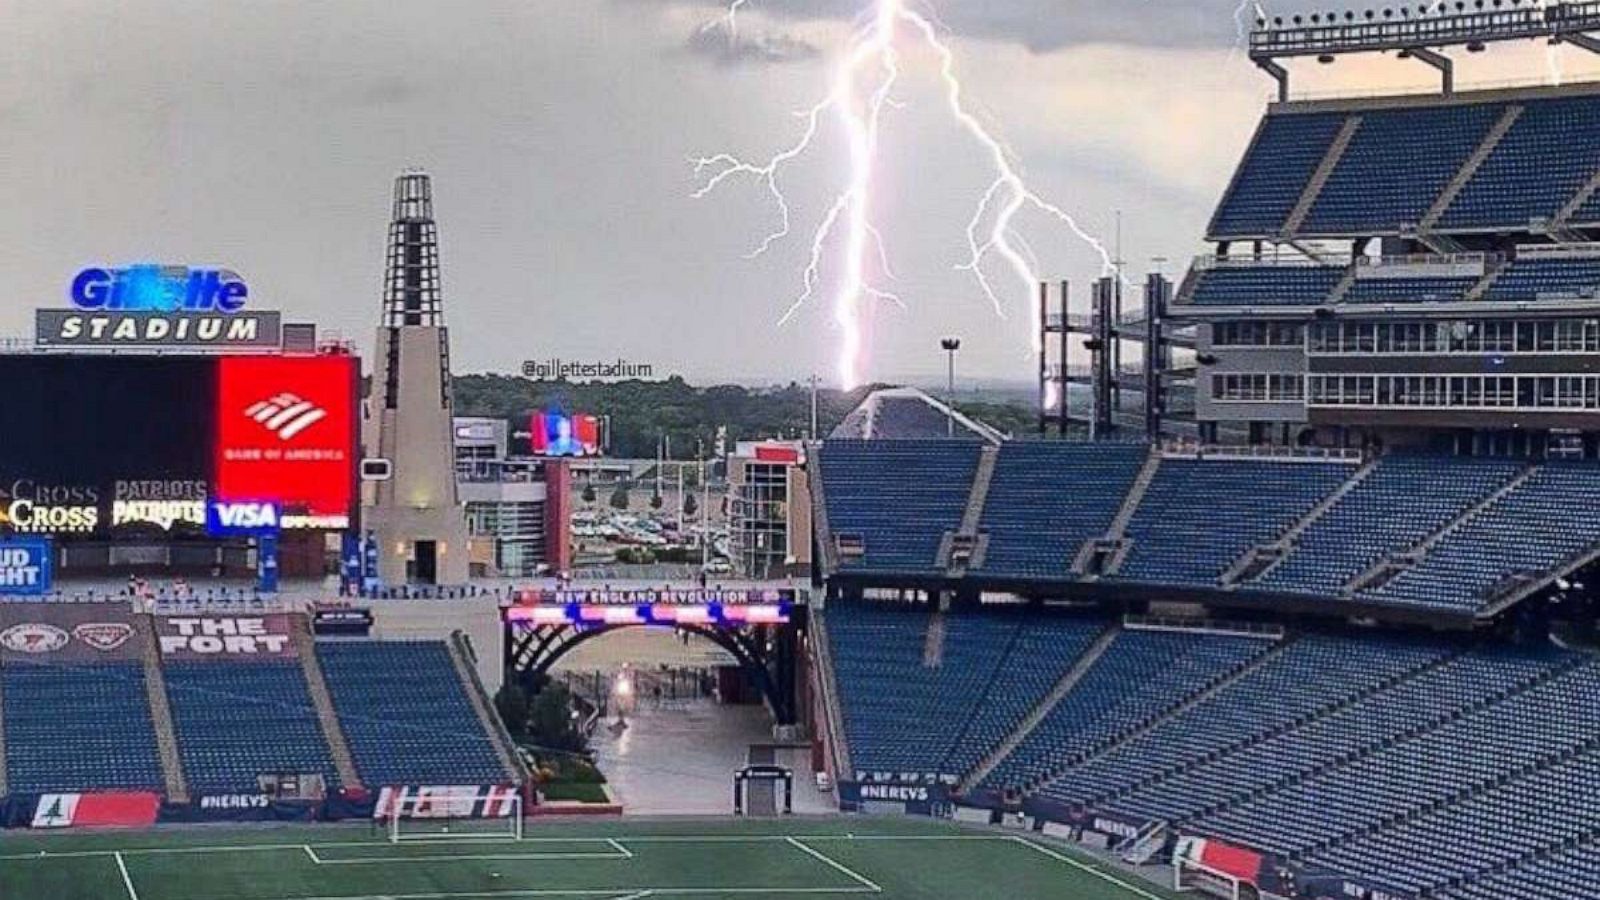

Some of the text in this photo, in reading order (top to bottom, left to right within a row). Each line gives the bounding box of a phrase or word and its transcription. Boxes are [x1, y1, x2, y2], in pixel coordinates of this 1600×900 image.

[60, 317, 258, 340] STADIUM
[115, 480, 207, 501] PATRIOTS
[112, 500, 207, 527] PATRIOTS
[216, 503, 277, 527] VISA
[555, 590, 586, 604] NEW
[590, 590, 656, 604] ENGLAND
[660, 590, 747, 604] REVOLUTION
[168, 618, 266, 635] THE
[160, 635, 288, 653] FORT
[860, 784, 928, 801] #NEREVS
